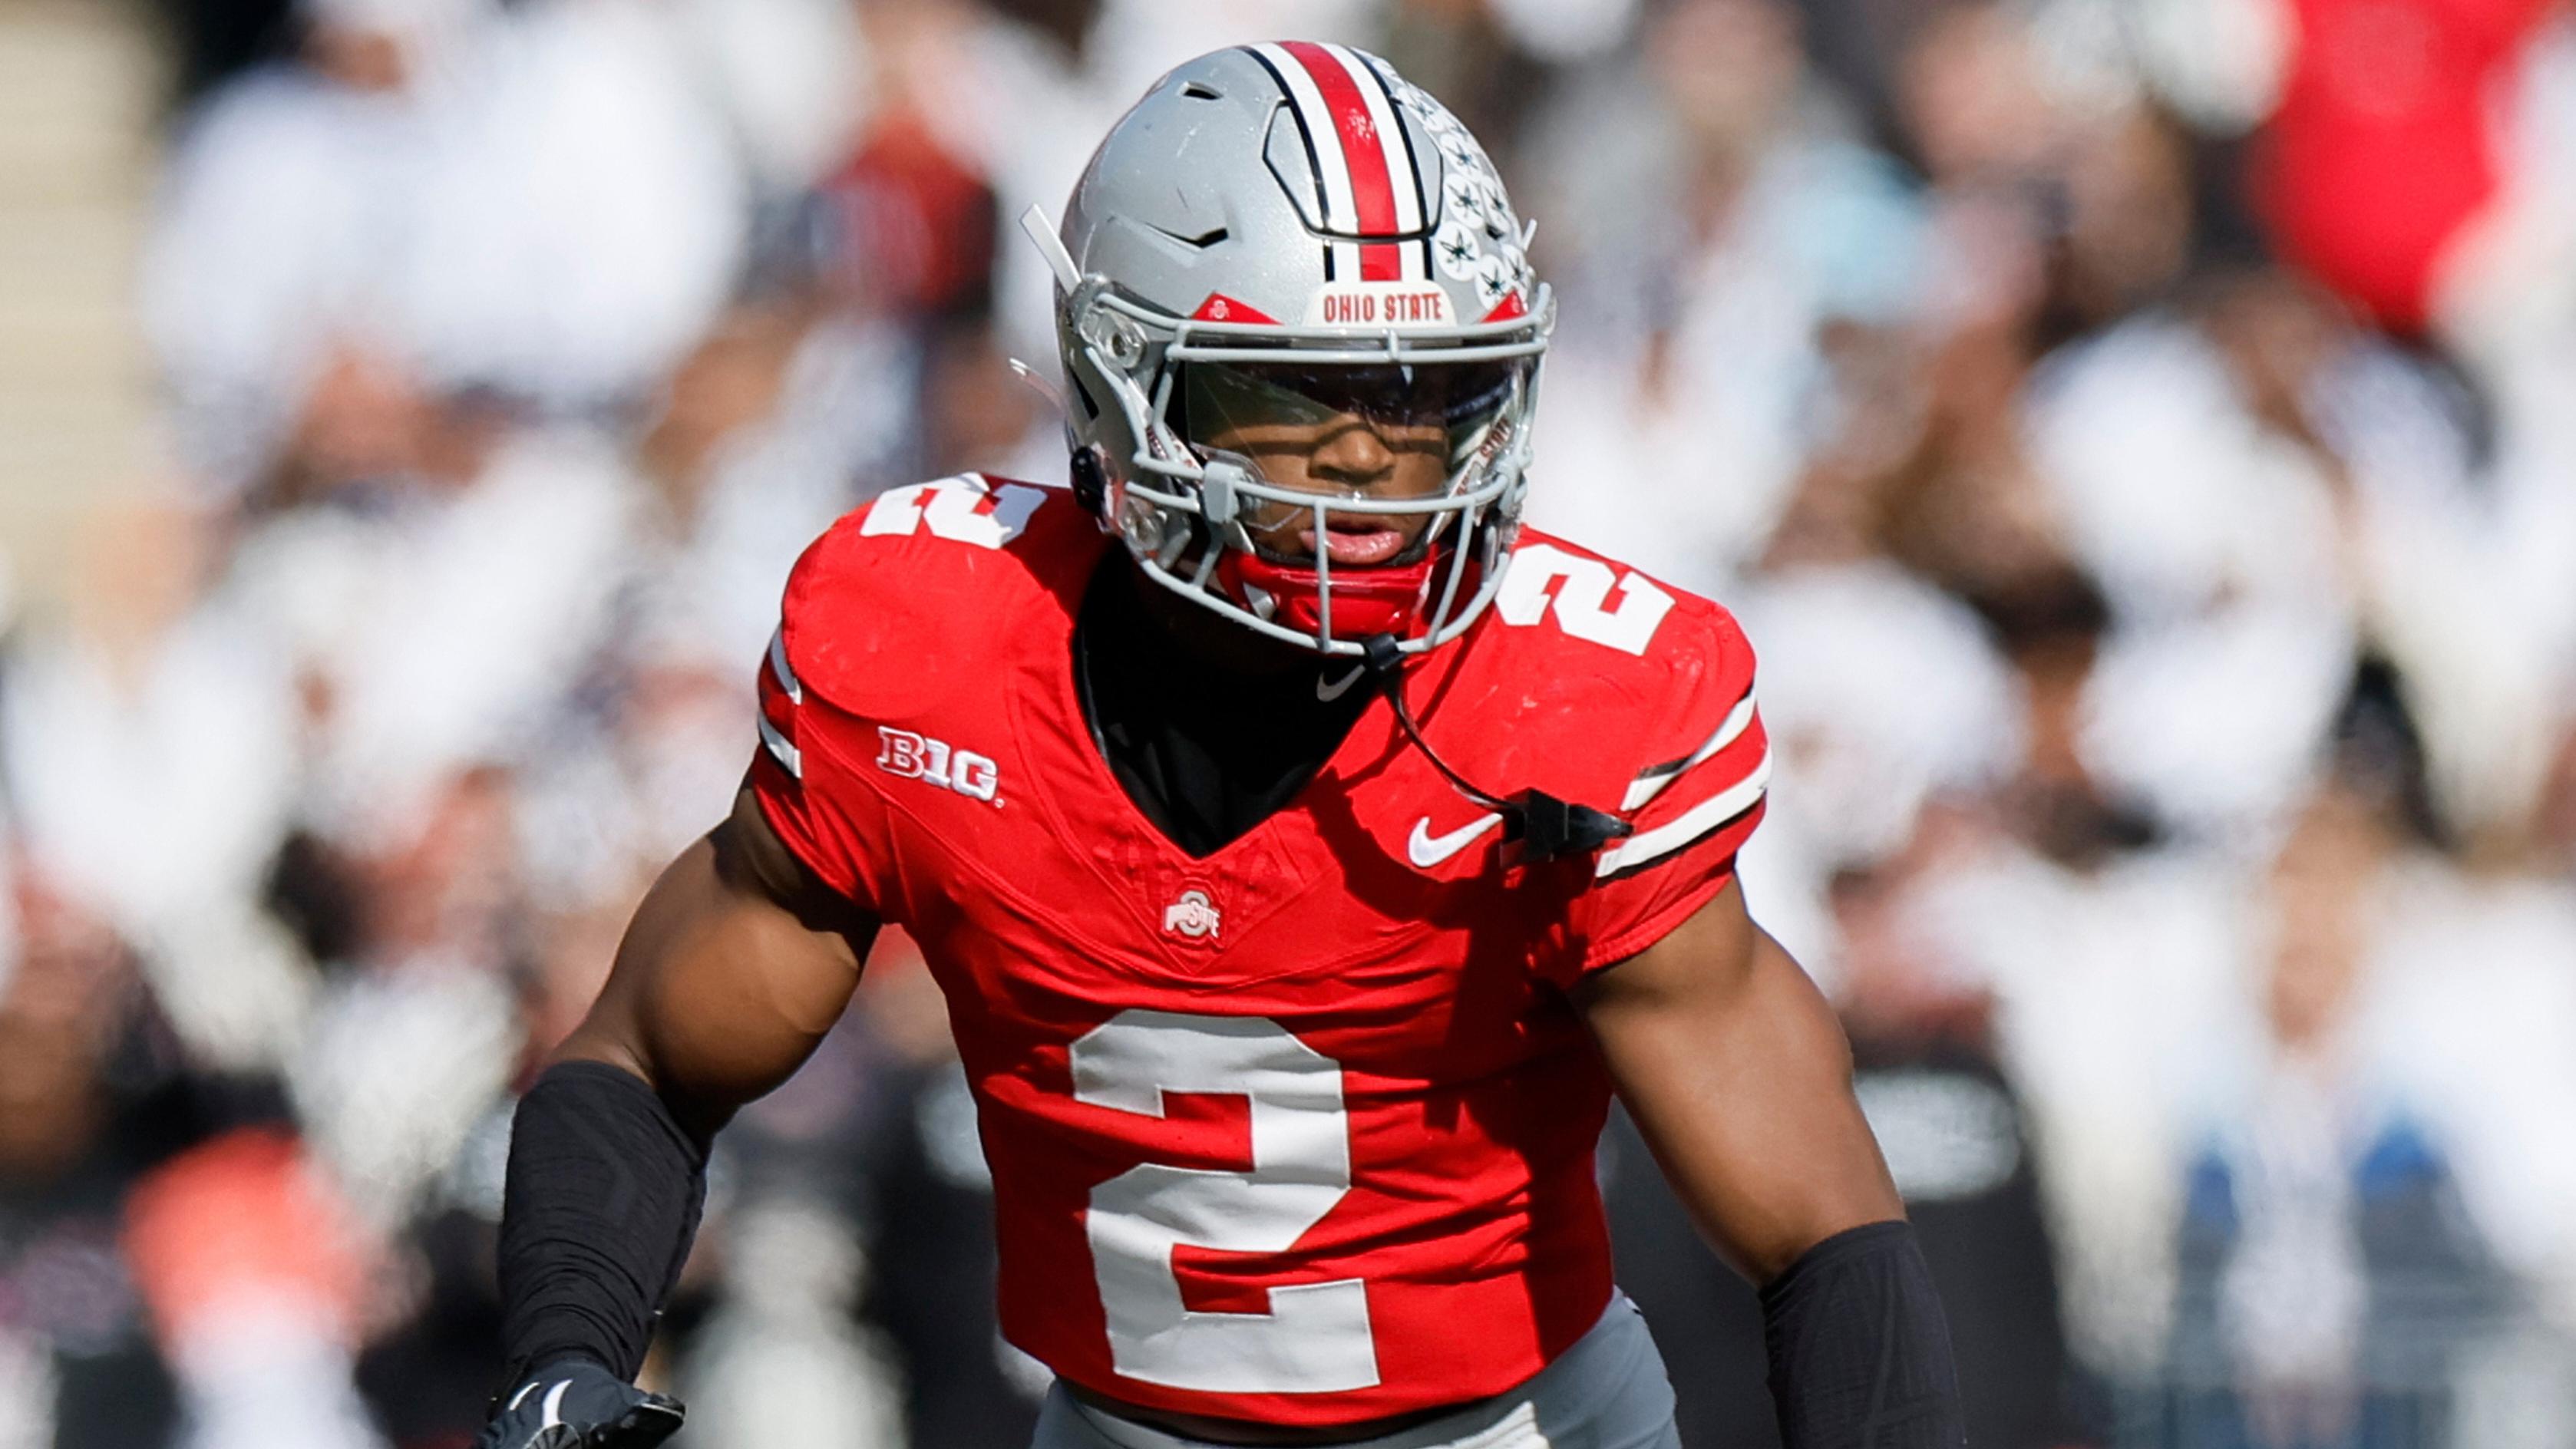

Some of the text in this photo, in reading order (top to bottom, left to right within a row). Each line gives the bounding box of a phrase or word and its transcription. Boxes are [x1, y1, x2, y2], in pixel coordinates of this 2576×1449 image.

[1325, 292, 1442, 322] OHIO STATE
[860, 471, 1048, 550] 2
[1494, 543, 1676, 656] 2
[1069, 1008, 1380, 1393] 2
